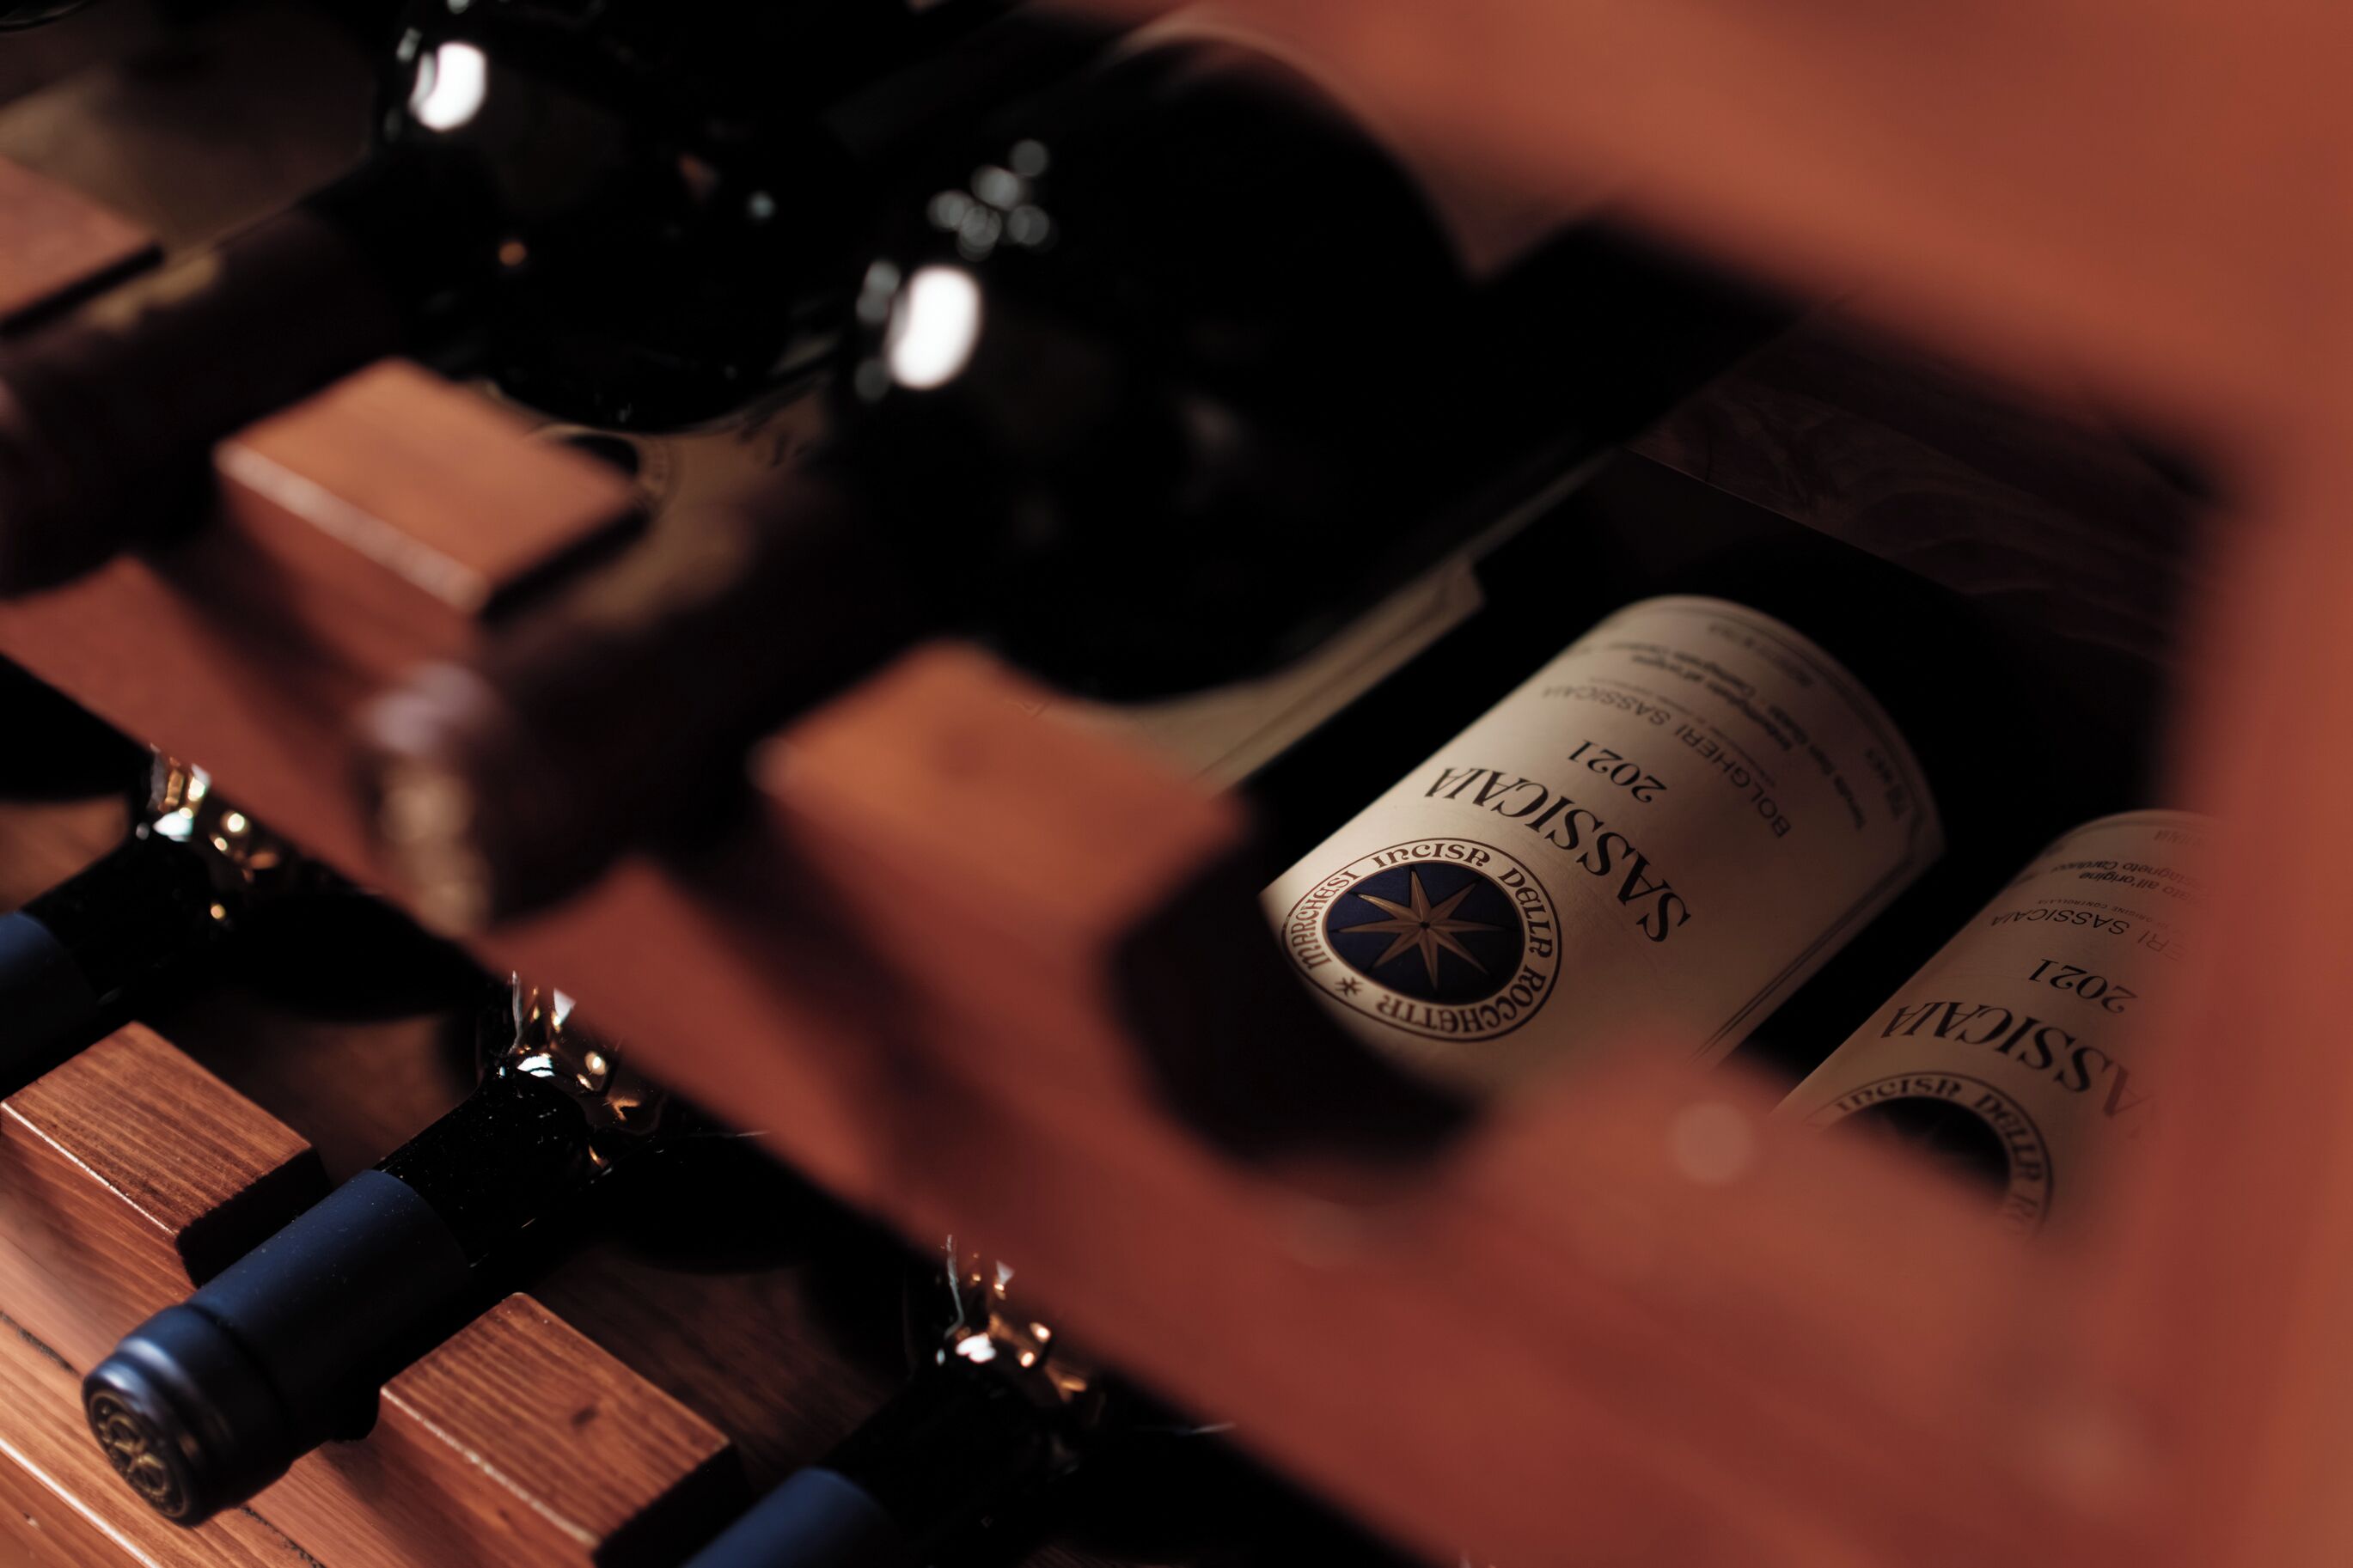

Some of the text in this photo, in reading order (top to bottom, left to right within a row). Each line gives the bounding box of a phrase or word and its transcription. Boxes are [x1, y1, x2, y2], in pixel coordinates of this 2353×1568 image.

[1568, 740, 1668, 803] 2021
[1675, 724, 1791, 839] BOLGHERI
[1425, 768, 1691, 943] SASSICAIA
[1291, 843, 1553, 1034] MARCHESI INCISA DELLA ROCCHETTA
[1991, 908, 2130, 935] SASSICAIA
[2029, 959, 2138, 1015] 2021
[1880, 1002, 2153, 1132] ASSICAIA
